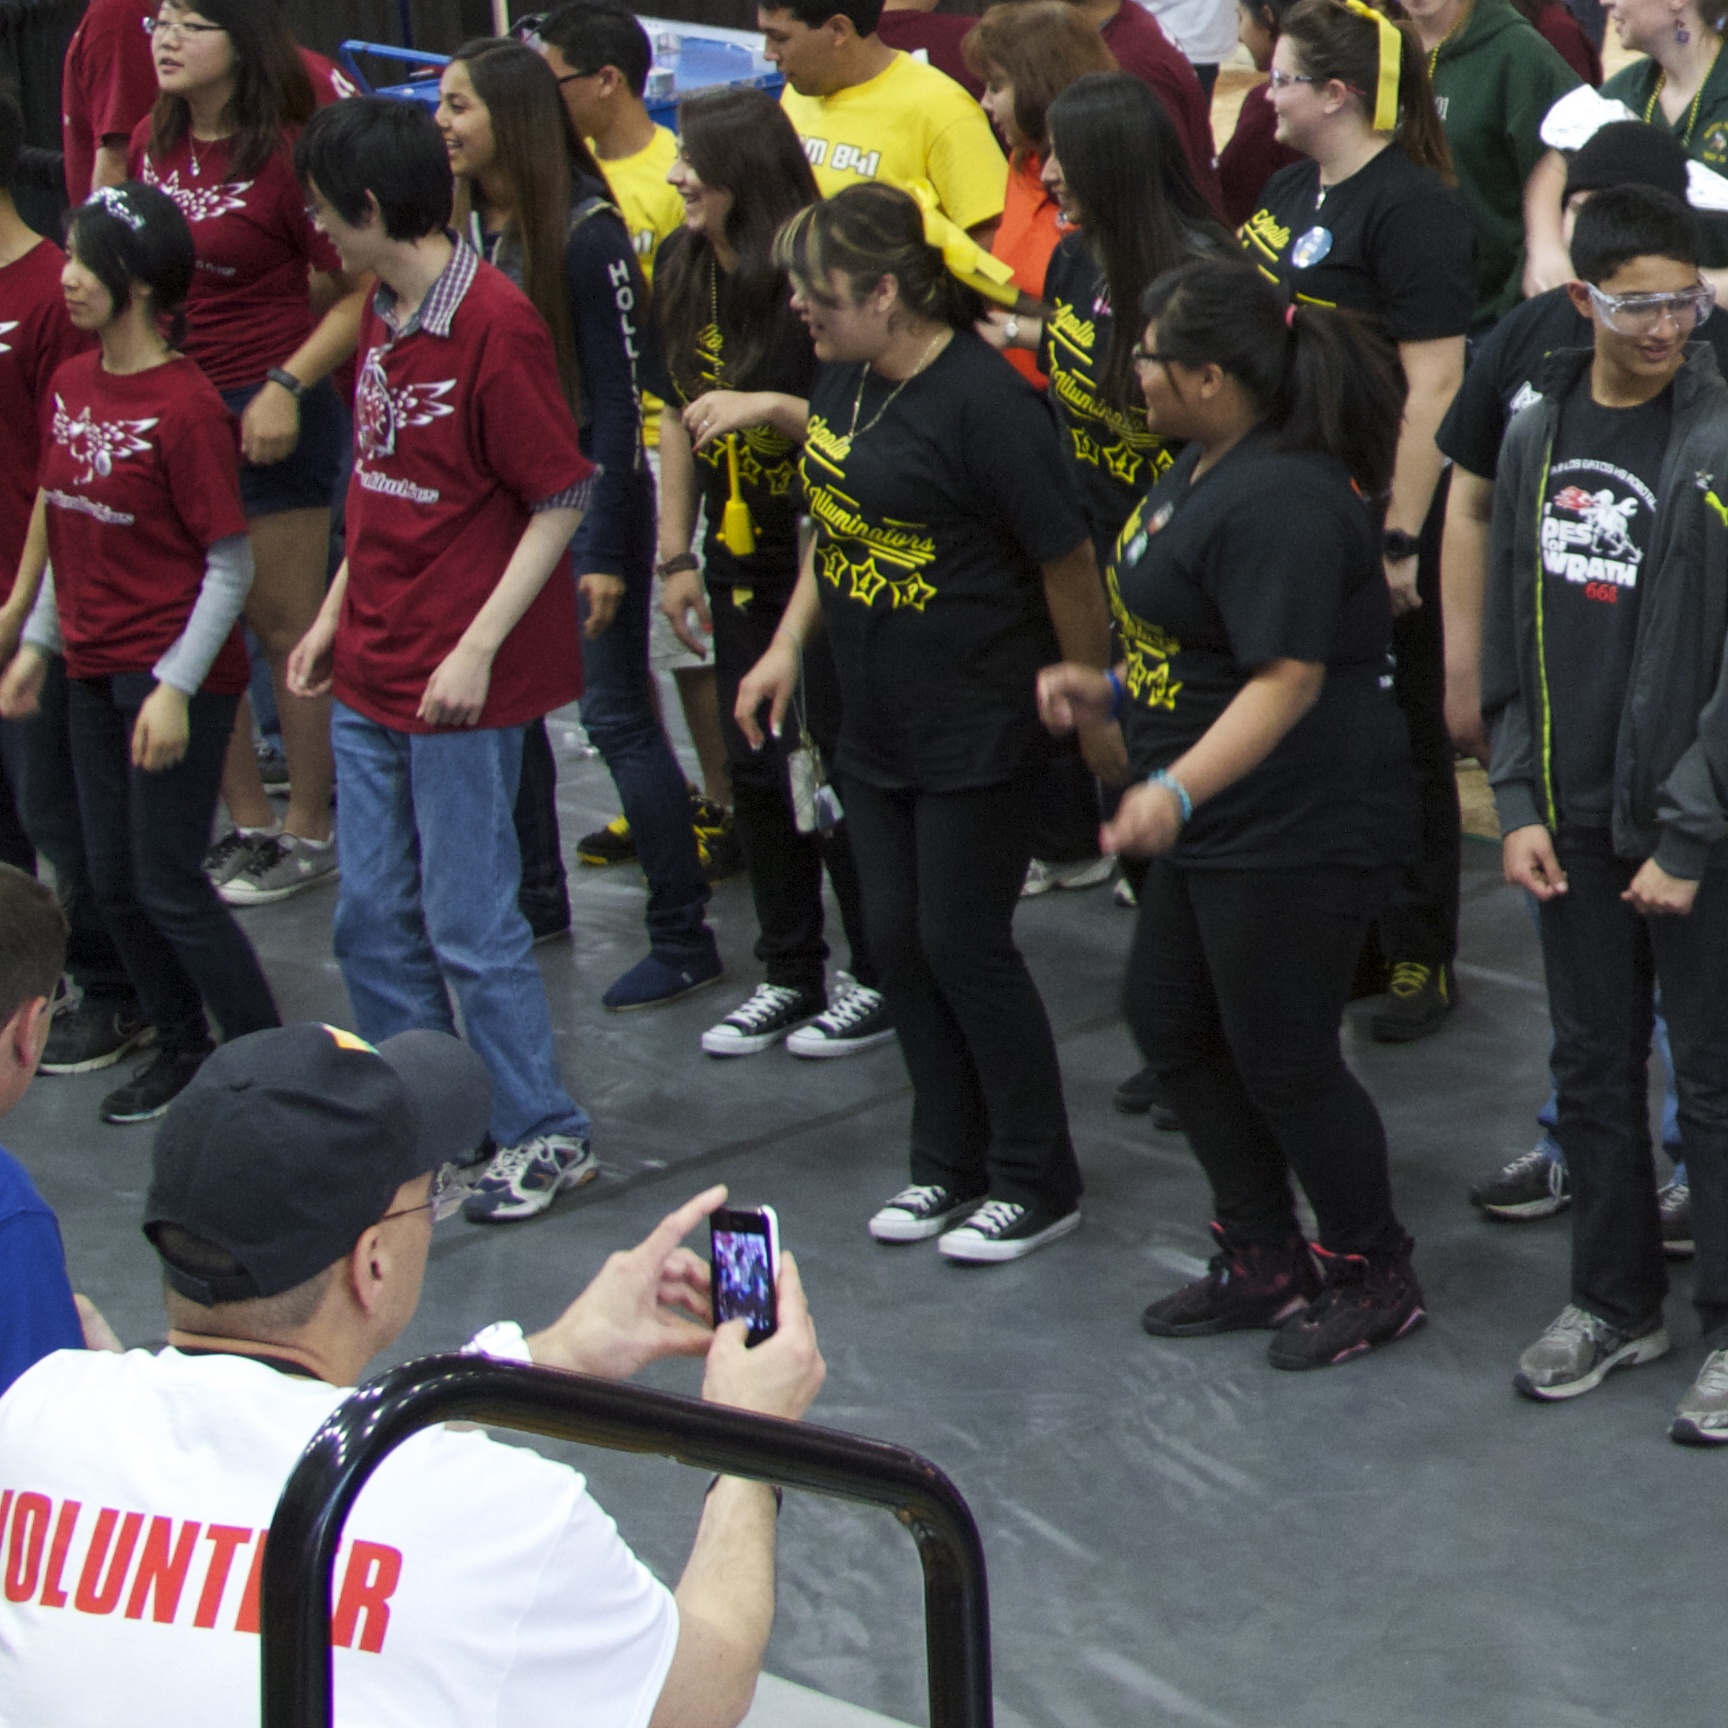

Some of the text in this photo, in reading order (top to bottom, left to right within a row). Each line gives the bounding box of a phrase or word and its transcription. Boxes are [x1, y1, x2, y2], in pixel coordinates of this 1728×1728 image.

[830, 140, 880, 178] 841
[1543, 549, 1638, 589] WRATH
[0, 1489, 403, 1654] OLUNTR
